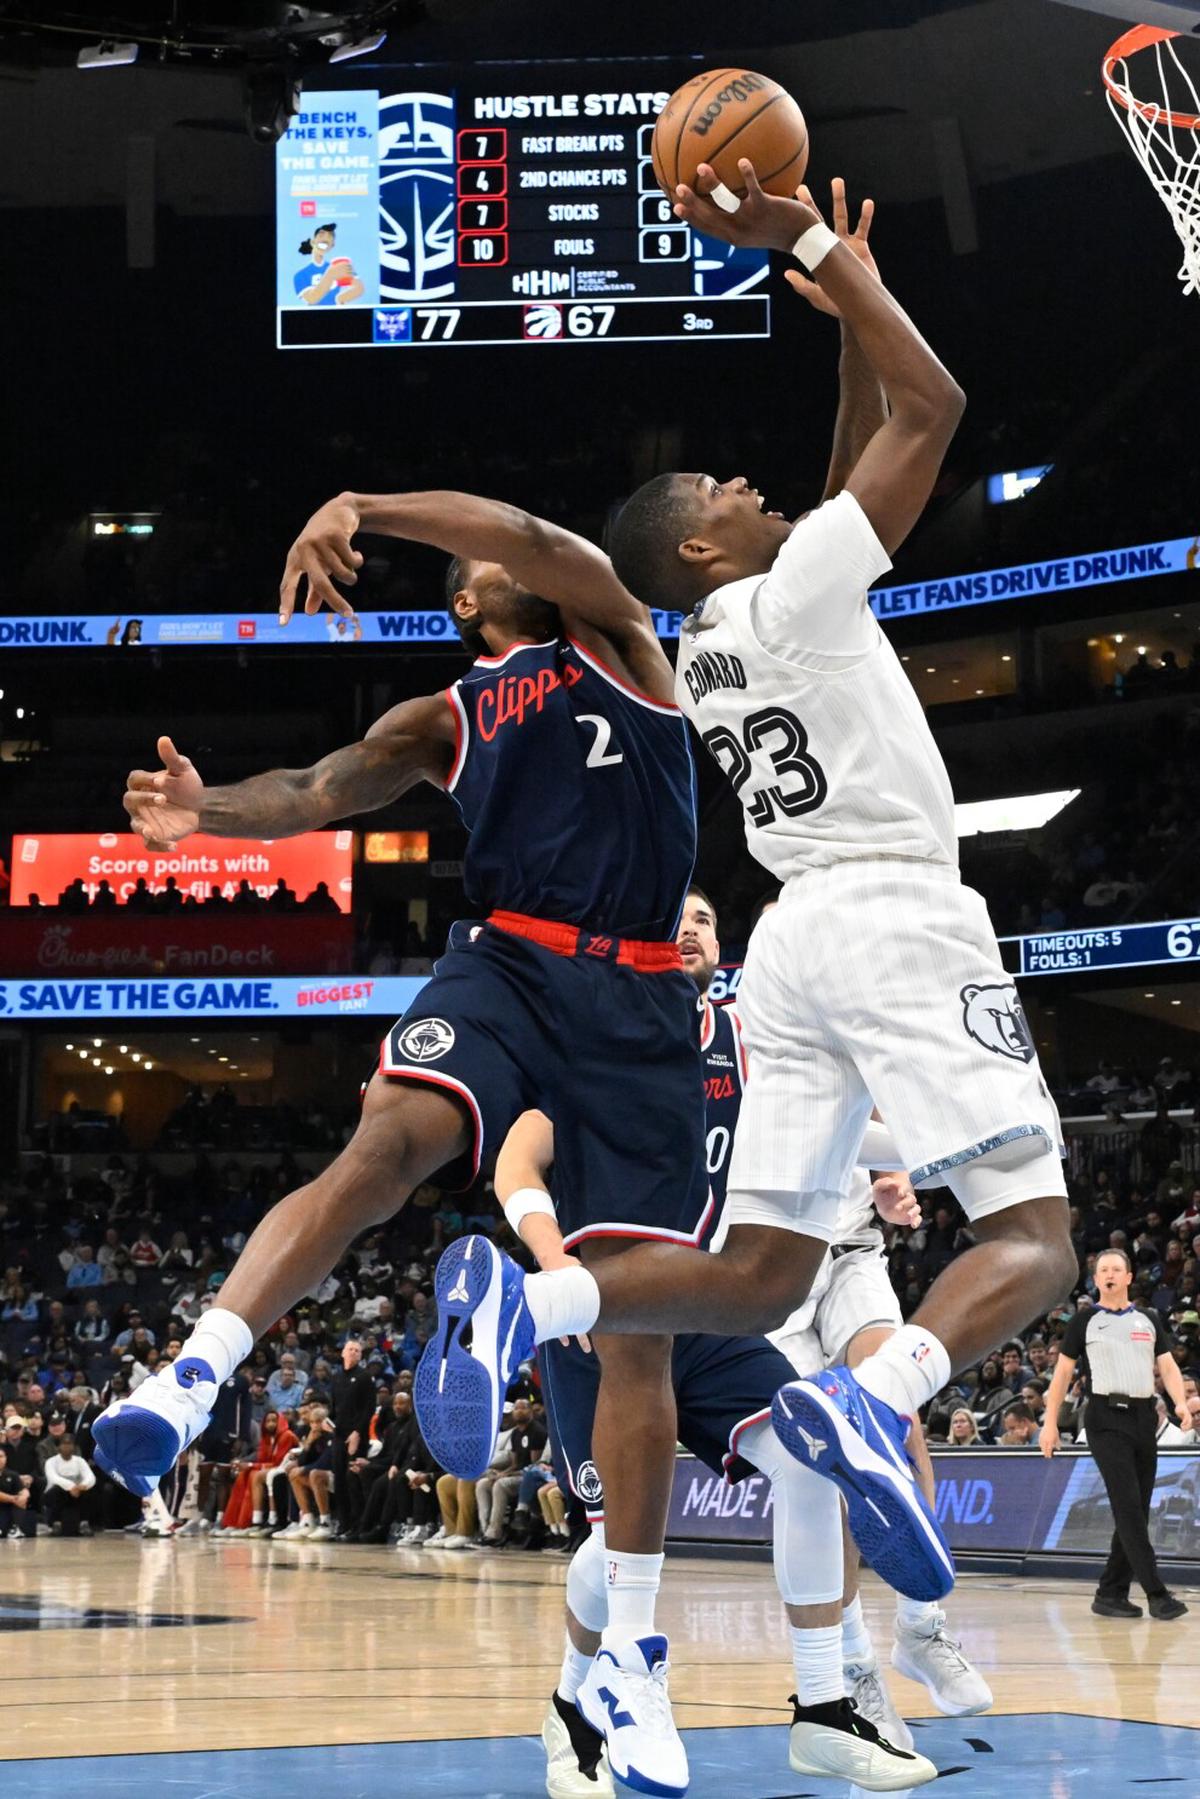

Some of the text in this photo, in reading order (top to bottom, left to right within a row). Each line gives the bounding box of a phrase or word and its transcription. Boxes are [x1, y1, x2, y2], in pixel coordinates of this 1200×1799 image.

[299, 111, 357, 124] BENCH
[474, 92, 671, 119] HUSTLE STATS
[285, 126, 373, 139] THE KEYS,
[302, 140, 349, 155] SAVE
[476, 134, 625, 158] 7 FAST BREAK PTS
[281, 155, 375, 170] THE GAME.
[476, 169, 627, 191] 4 2ND CHANCE PTS
[477, 200, 671, 226] 7 STOCKS 6
[473, 234, 671, 260] 10 FOULS 9
[512, 270, 570, 296] HHM
[416, 305, 714, 340] 77 67 3RD
[879, 587, 921, 614] LET
[924, 576, 987, 607] FANS
[990, 563, 1070, 596] DRIVE
[1073, 546, 1172, 579] DRUNK.
[0, 621, 92, 643] DRUNK.
[684, 651, 747, 705] COWARD
[477, 663, 584, 743] Clipps
[575, 714, 623, 769] 2
[701, 706, 828, 829] 23
[88, 854, 270, 877] Score points with
[164, 944, 274, 966] FanDeck
[1028, 931, 1122, 953] TIMEOUTS: 5
[1029, 951, 1091, 970] FOULS: 1
[19, 984, 103, 1011] SAVE
[106, 984, 171, 1010] THE
[174, 982, 279, 1010] GAME.
[297, 981, 374, 1007] BIGGEST
[682, 1478, 762, 1518] MADE
